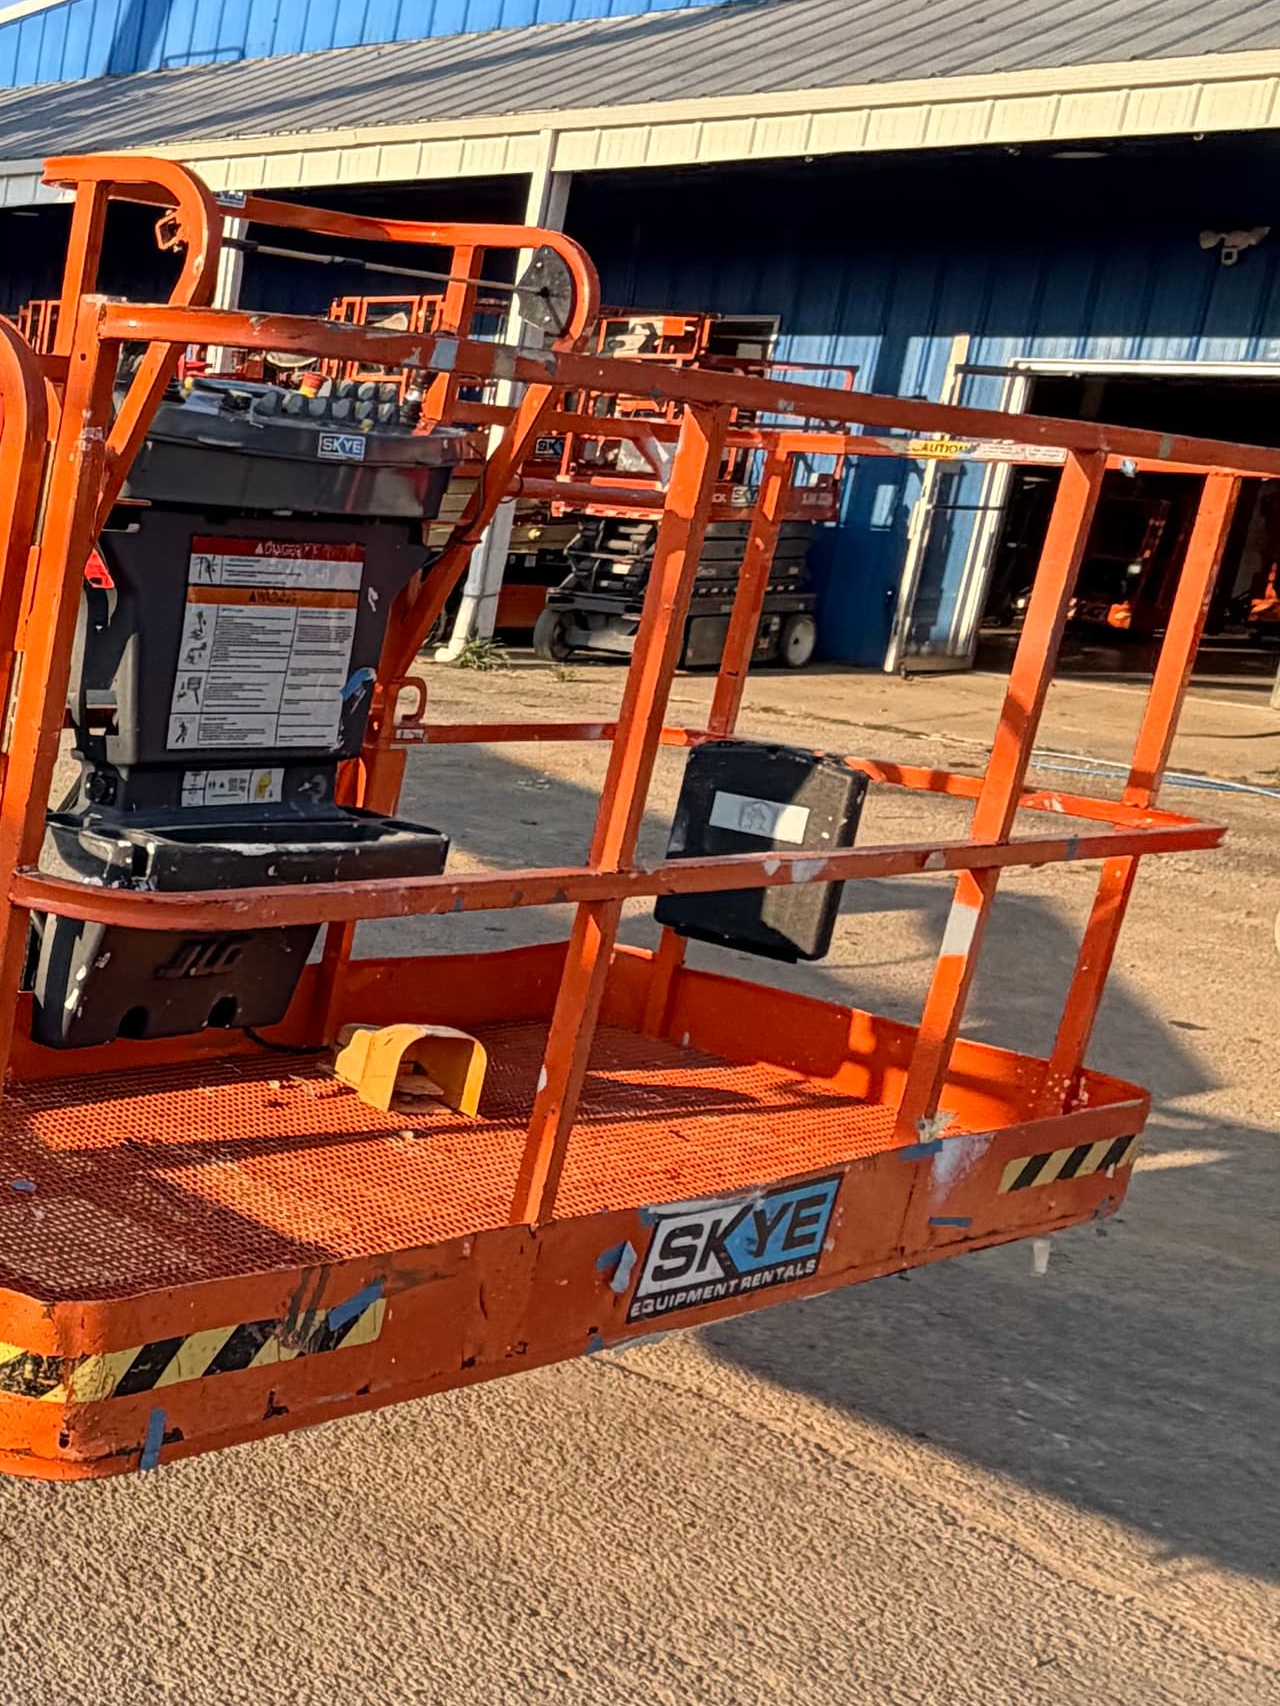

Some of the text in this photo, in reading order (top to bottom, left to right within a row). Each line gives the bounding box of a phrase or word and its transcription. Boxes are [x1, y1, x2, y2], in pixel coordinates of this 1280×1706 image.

[322, 436, 362, 454] SKYE
[650, 1193, 829, 1283] SKYE
[630, 1258, 817, 1318] EQUIPMENT RENTALS
